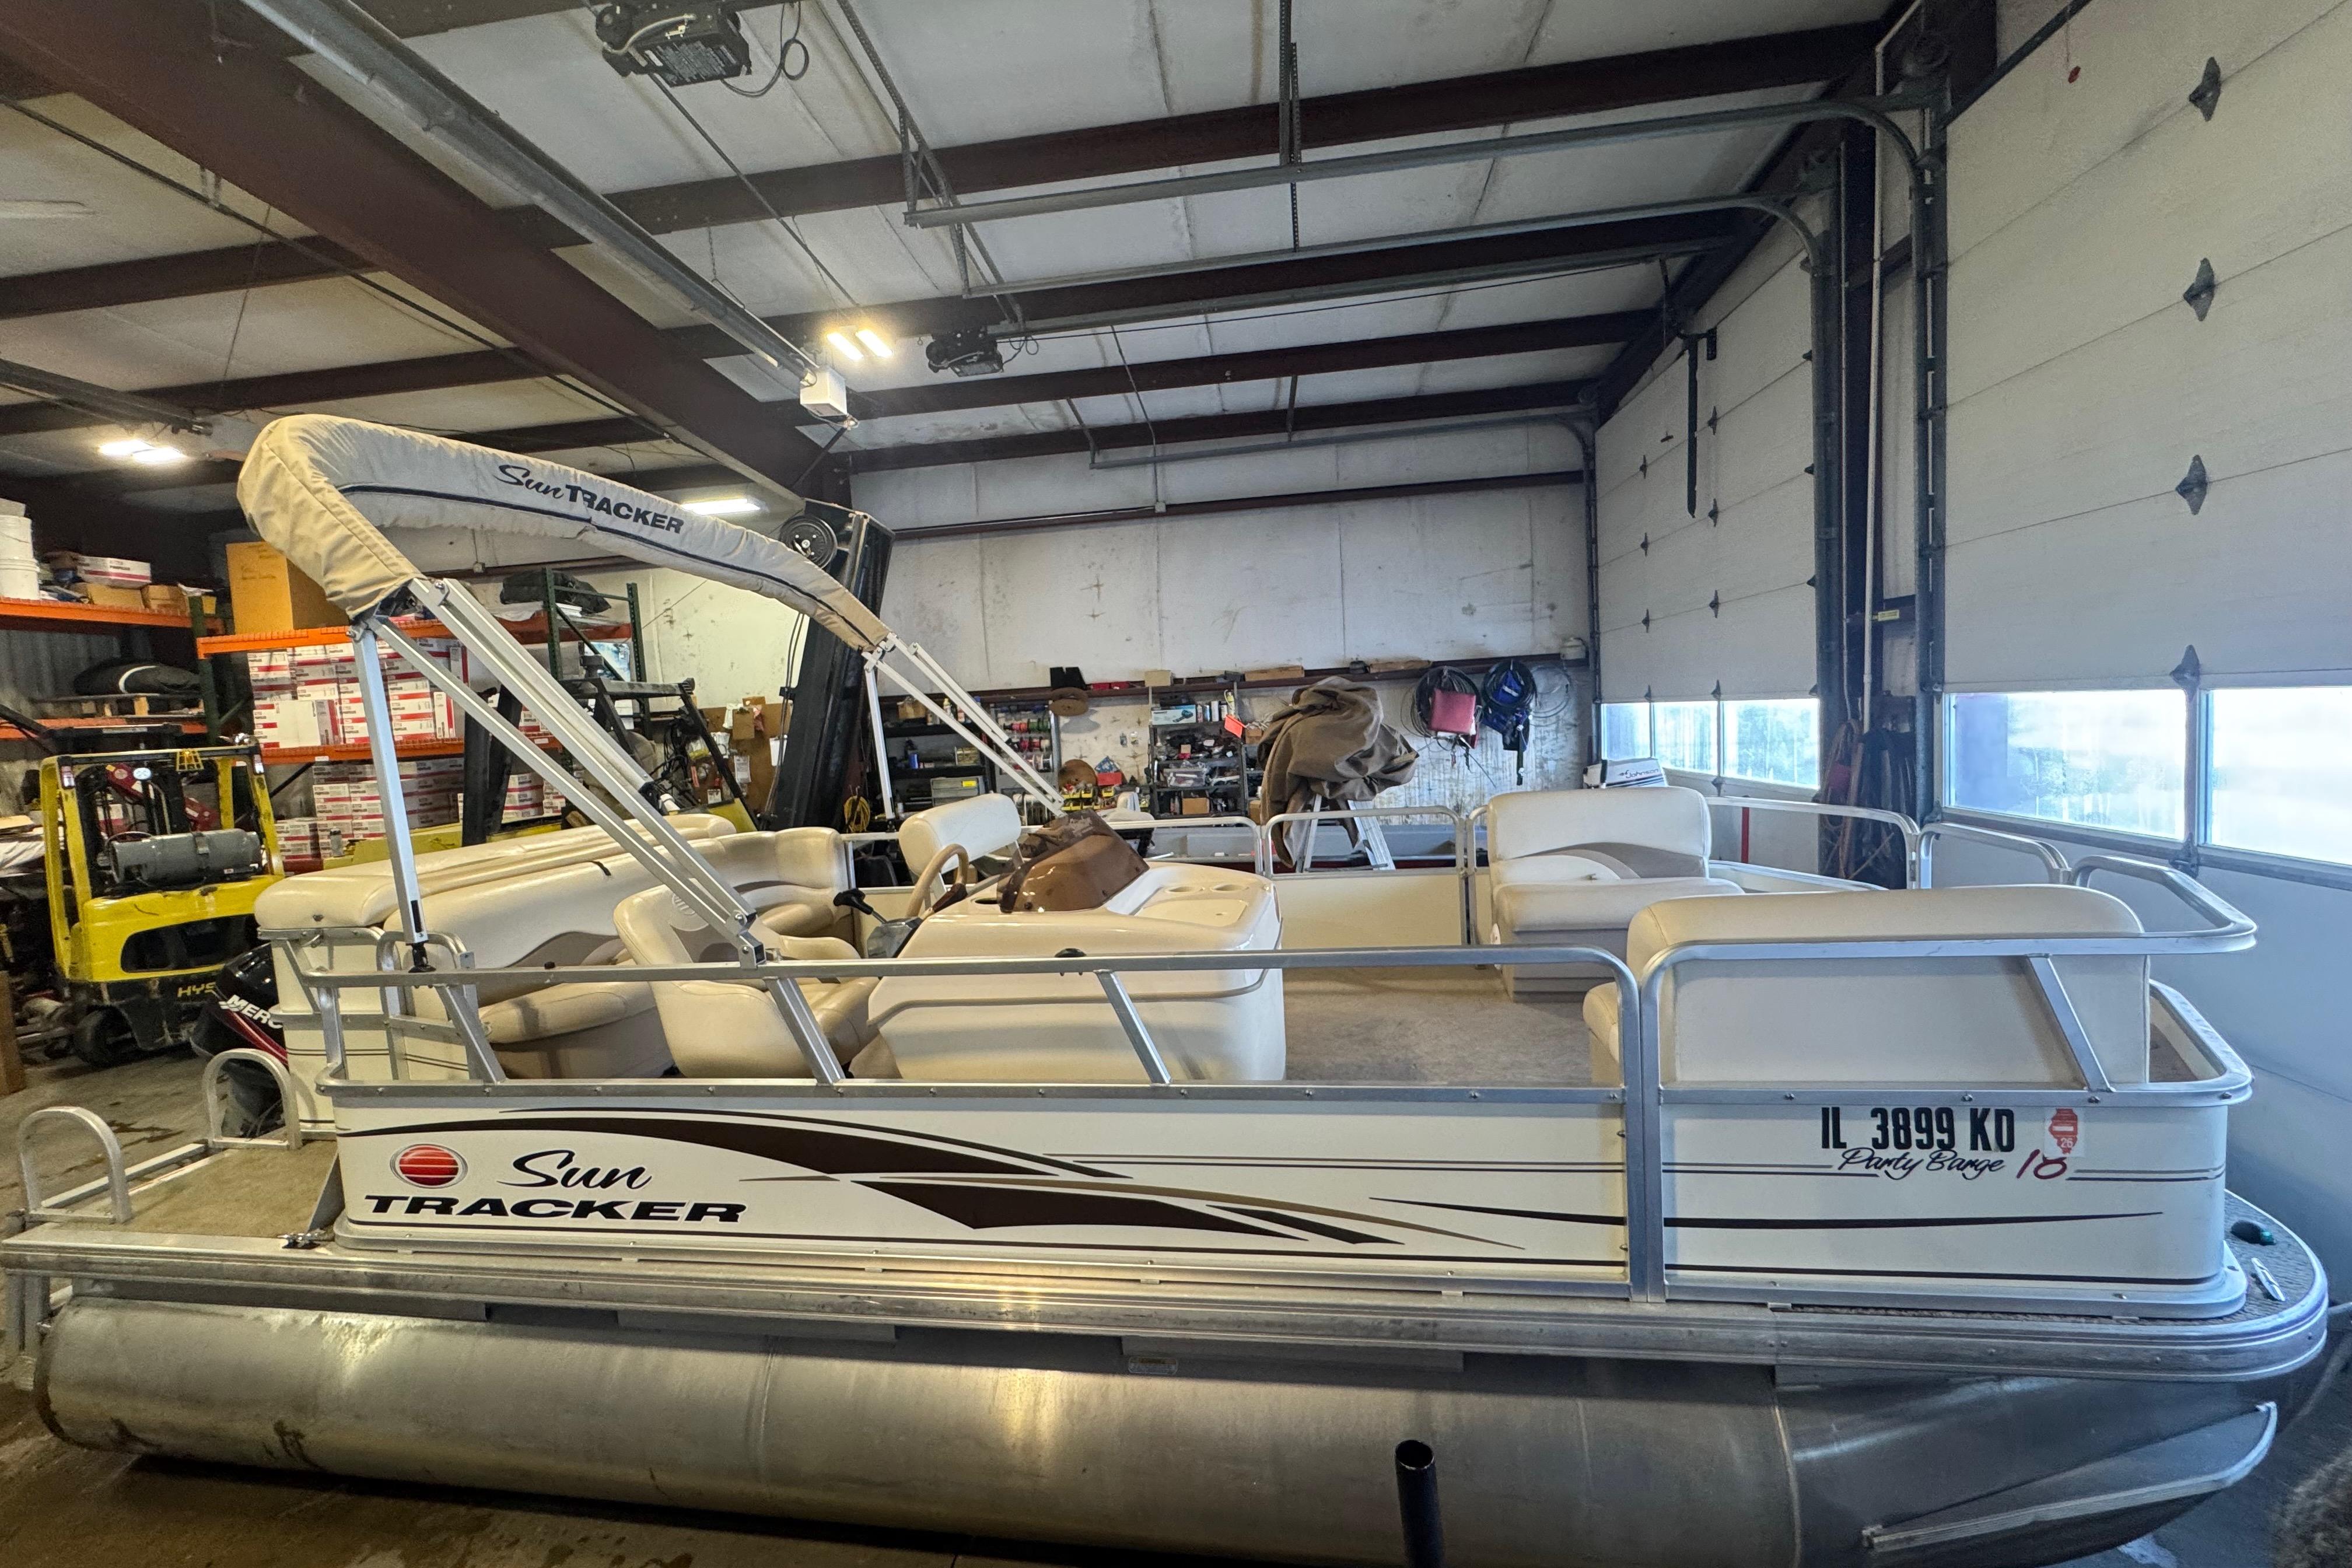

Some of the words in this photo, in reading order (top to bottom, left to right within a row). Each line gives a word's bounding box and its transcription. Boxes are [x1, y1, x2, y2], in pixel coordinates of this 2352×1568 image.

[493, 464, 565, 499] Sun
[565, 484, 685, 534] TRACKER
[1626, 769, 1660, 779] Johnson
[177, 981, 216, 998] HYS
[219, 994, 284, 1030] MERC
[1821, 1107, 1847, 1149] IL
[1871, 1107, 1956, 1150] 3899
[2060, 1137, 2074, 1149] 26
[496, 1150, 652, 1189] Sun
[1838, 1147, 1924, 1181] Party
[1926, 1148, 2006, 1180] Barge
[2016, 1148, 2067, 1180] 18
[365, 1195, 747, 1223] TRACKER
